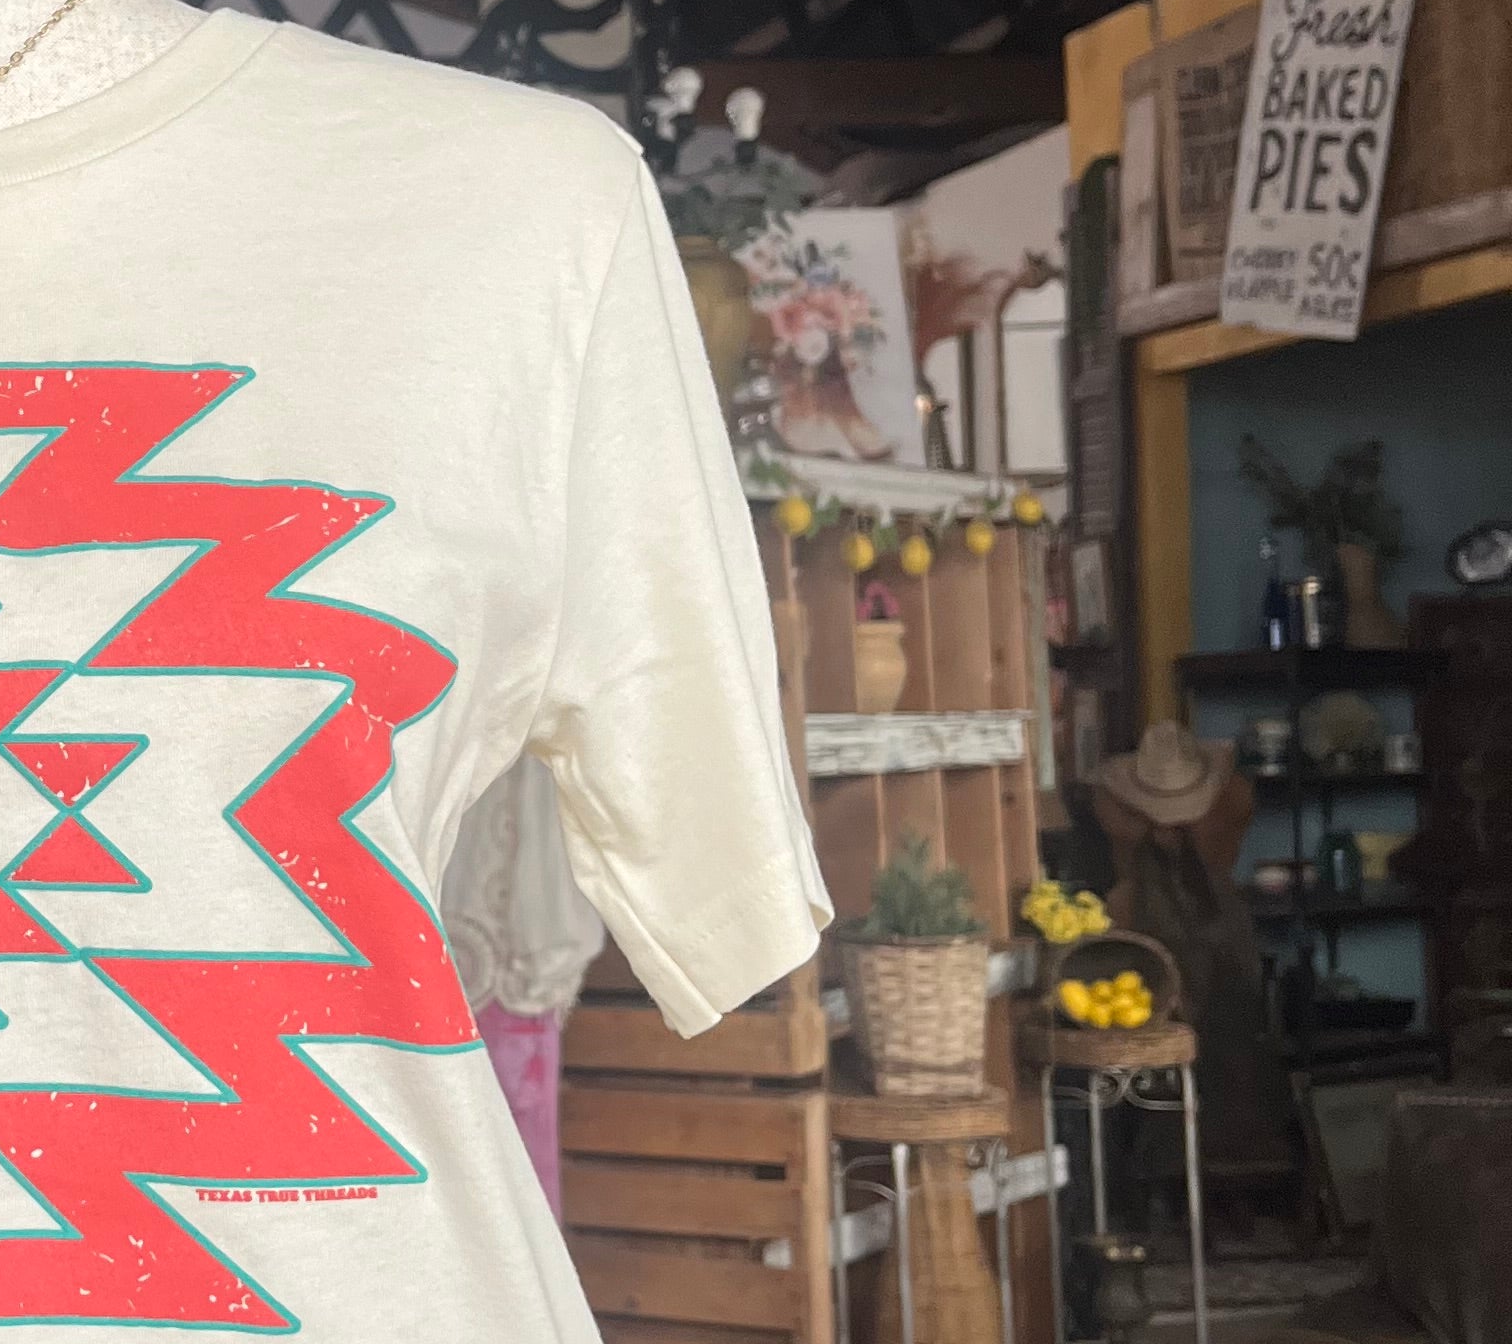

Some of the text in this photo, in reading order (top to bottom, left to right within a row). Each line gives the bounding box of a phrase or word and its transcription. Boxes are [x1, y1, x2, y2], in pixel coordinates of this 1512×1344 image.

[1262, 63, 1388, 121] BAKED
[1249, 128, 1377, 215] PIES
[195, 1186, 379, 1204] TEXAS TRUE THREADS
